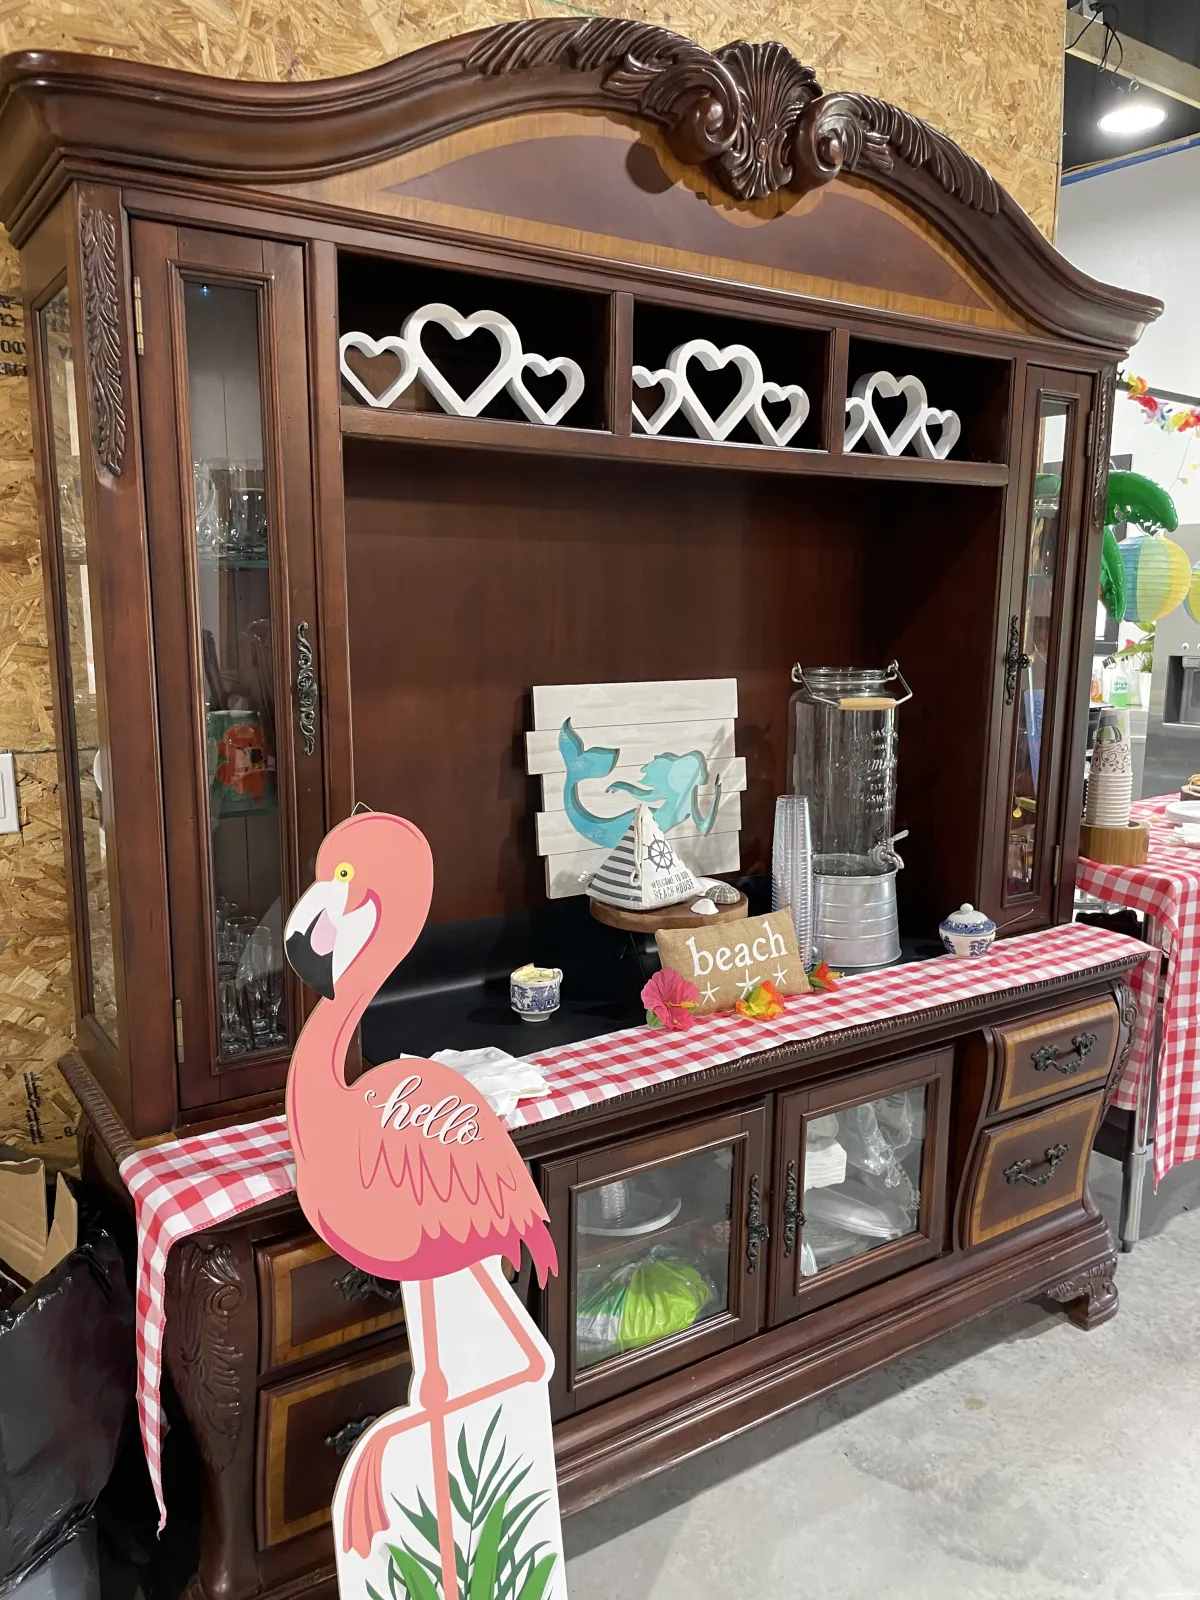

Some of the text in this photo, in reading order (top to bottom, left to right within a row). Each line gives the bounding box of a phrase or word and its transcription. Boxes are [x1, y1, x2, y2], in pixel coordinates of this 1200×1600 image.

[651, 870, 691, 889] WELCOME TO OUR
[653, 879, 694, 900] BEACH HOUSE
[685, 920, 789, 977] beach
[364, 1075, 485, 1145] hello
